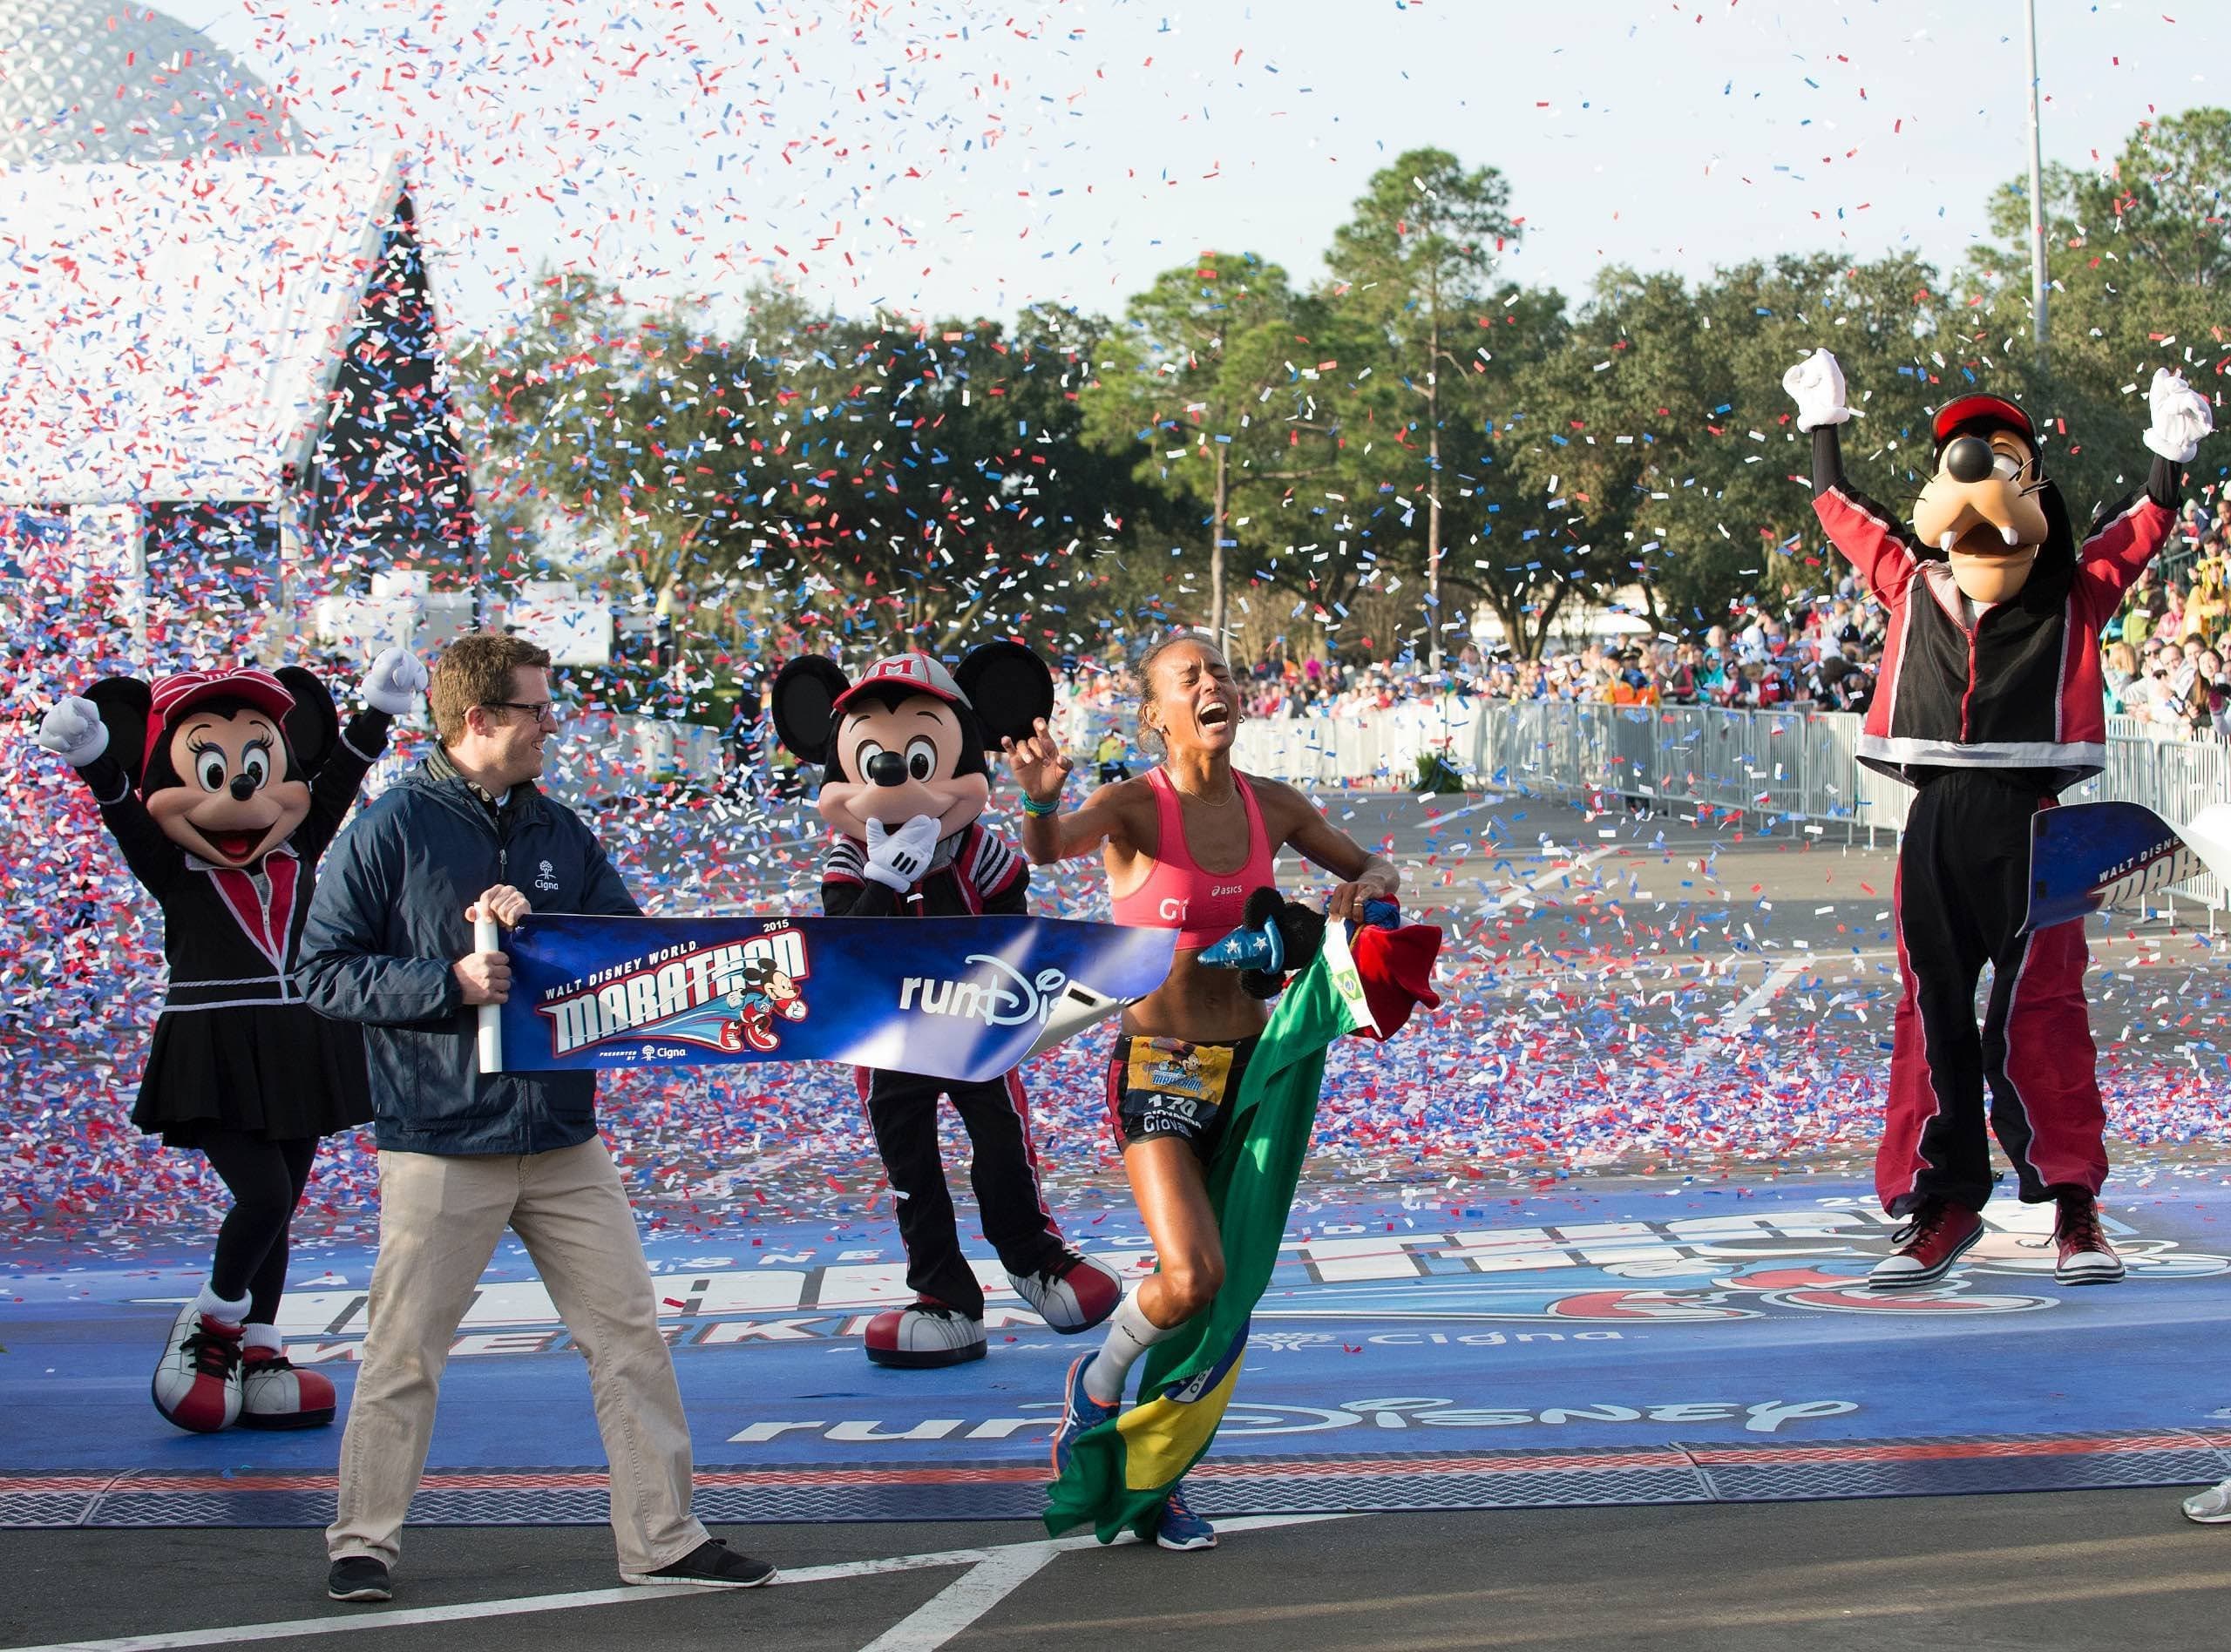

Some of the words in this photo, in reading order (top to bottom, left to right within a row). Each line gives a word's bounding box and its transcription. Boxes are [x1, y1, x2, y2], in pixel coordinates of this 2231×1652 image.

[2099, 857, 2134, 884] WALT
[2140, 836, 2180, 863] DISNE
[534, 879, 559, 890] Cigna
[763, 919, 790, 933] 2015
[545, 979, 582, 1000] WALT
[589, 957, 642, 985] DISNEY
[648, 940, 697, 964] WORLD
[537, 931, 807, 1053] MARATHON
[657, 1047, 686, 1060] Cigna
[1367, 1330, 1625, 1347] Cigna
